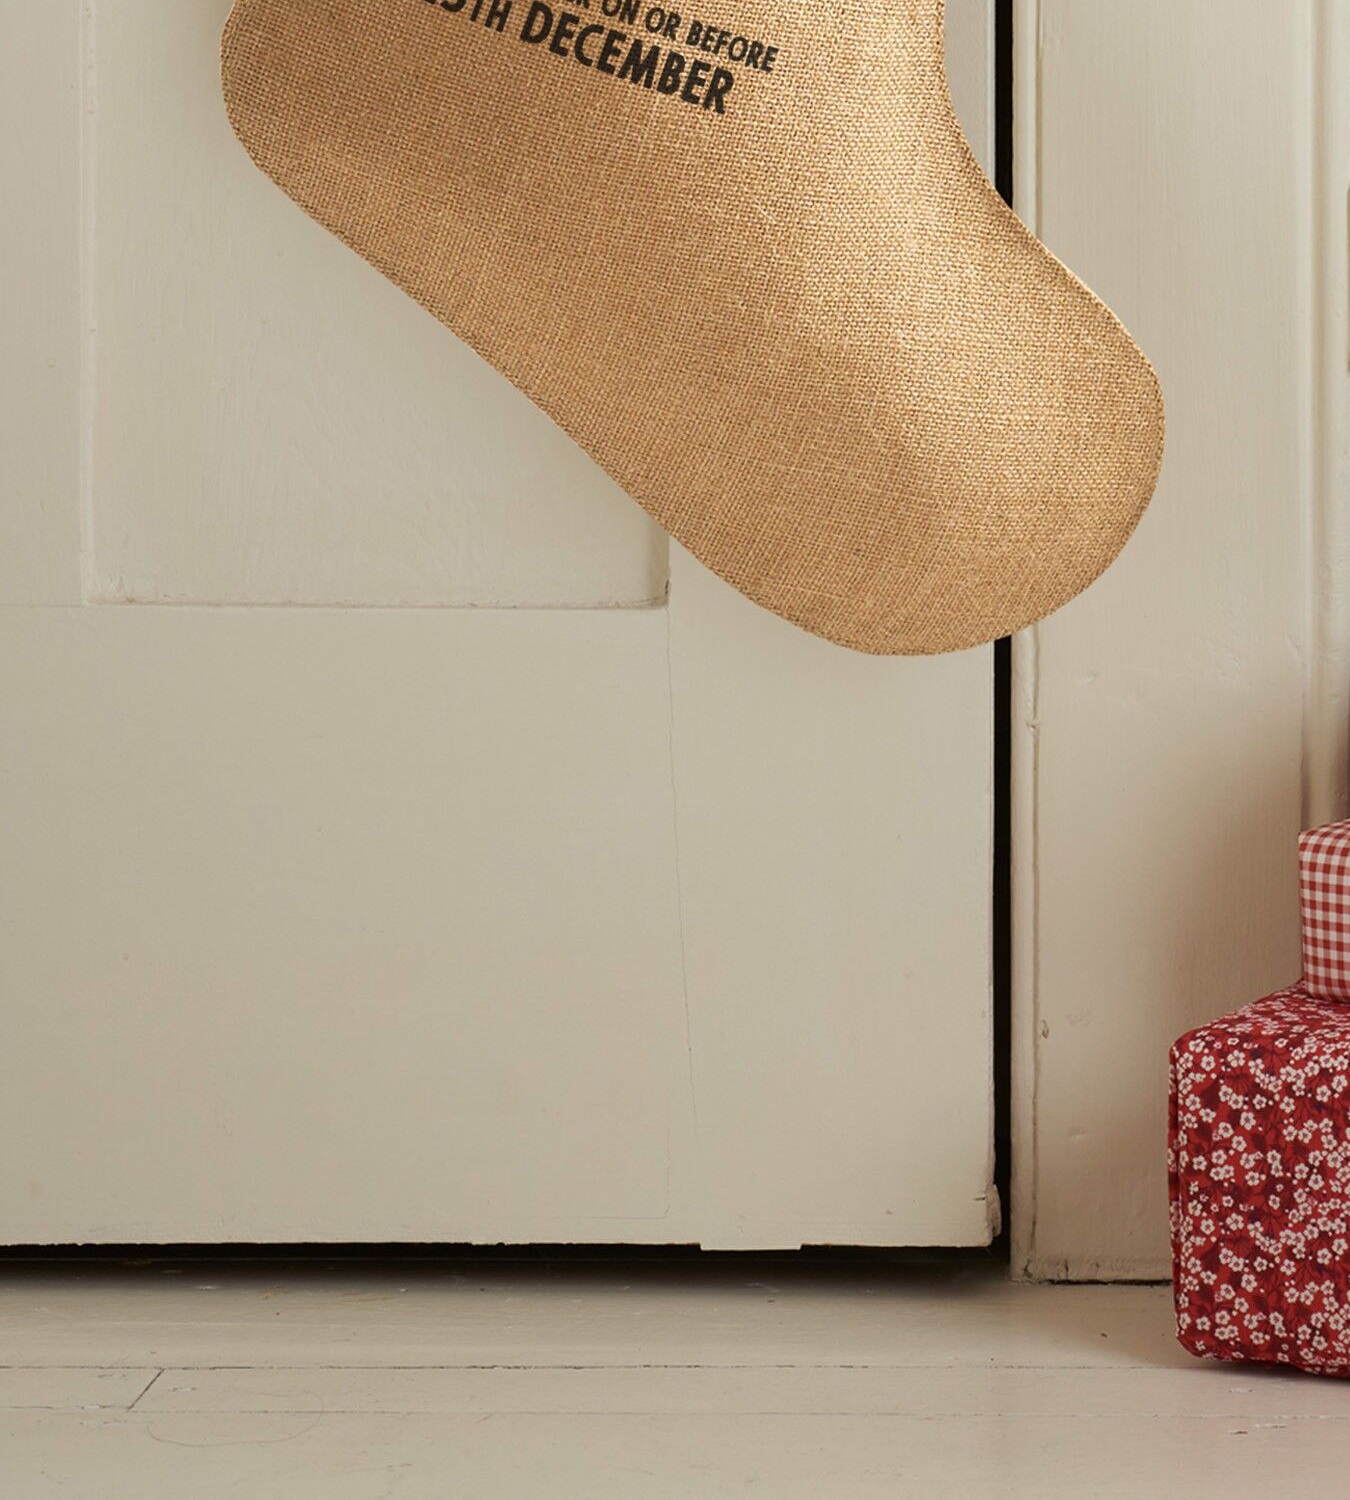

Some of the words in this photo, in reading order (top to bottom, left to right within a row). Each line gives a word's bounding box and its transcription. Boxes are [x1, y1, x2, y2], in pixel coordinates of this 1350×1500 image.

[520, 1, 735, 113] DECEMBER
[645, 6, 680, 41] OR
[687, 21, 779, 72] BEFORE
